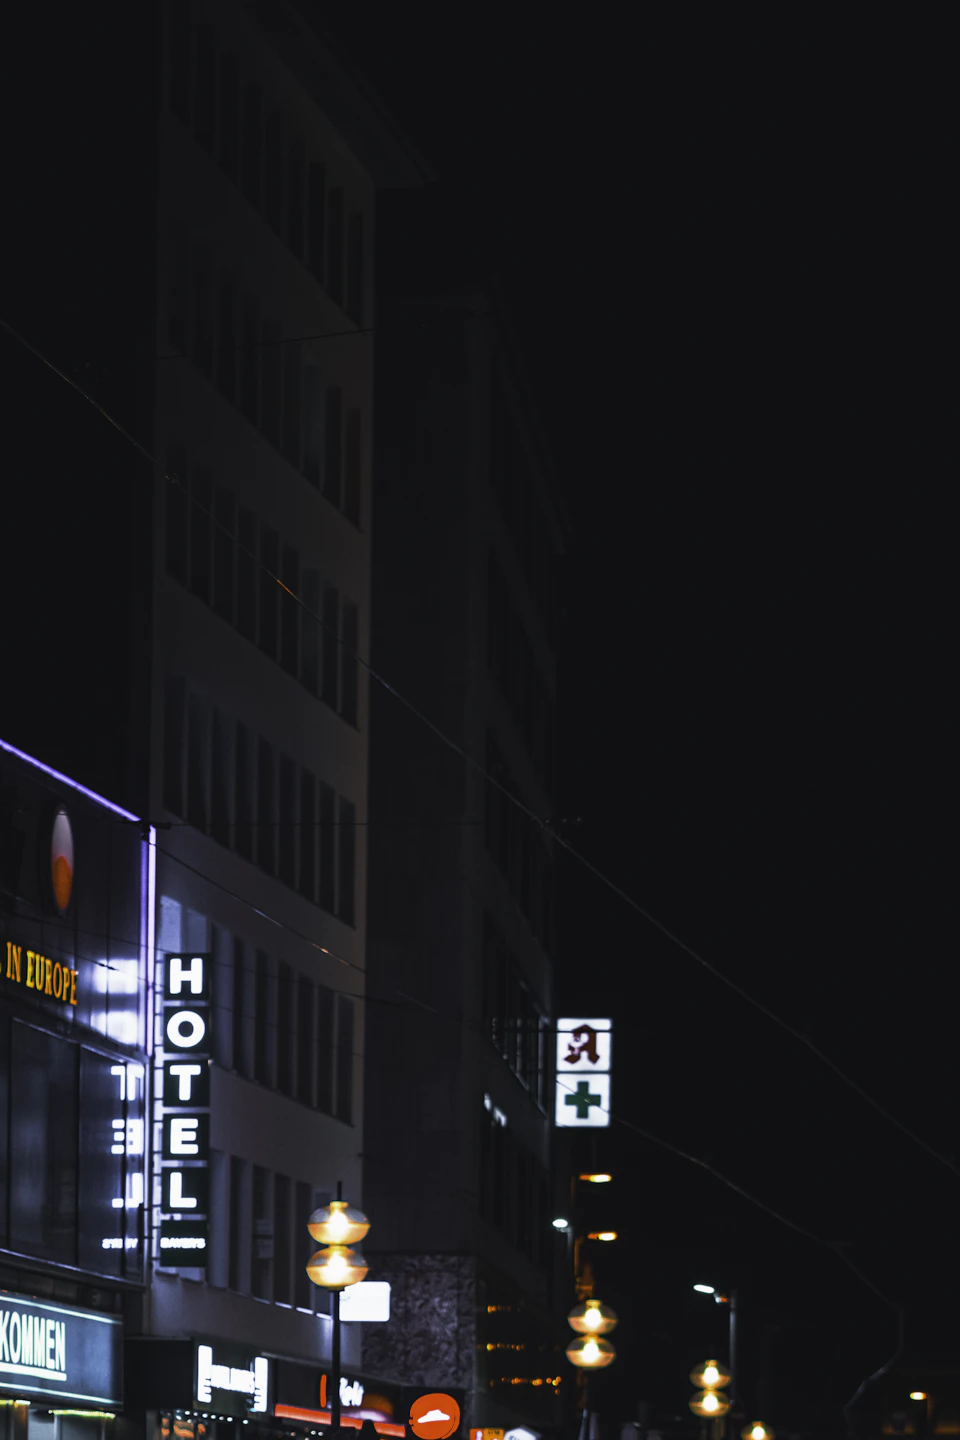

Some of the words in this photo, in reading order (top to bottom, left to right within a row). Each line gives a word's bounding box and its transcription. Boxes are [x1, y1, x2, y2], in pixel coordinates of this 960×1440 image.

[6, 942, 22, 982] IN
[26, 950, 78, 1005] EUROPE
[167, 958, 205, 1207] HOTEL
